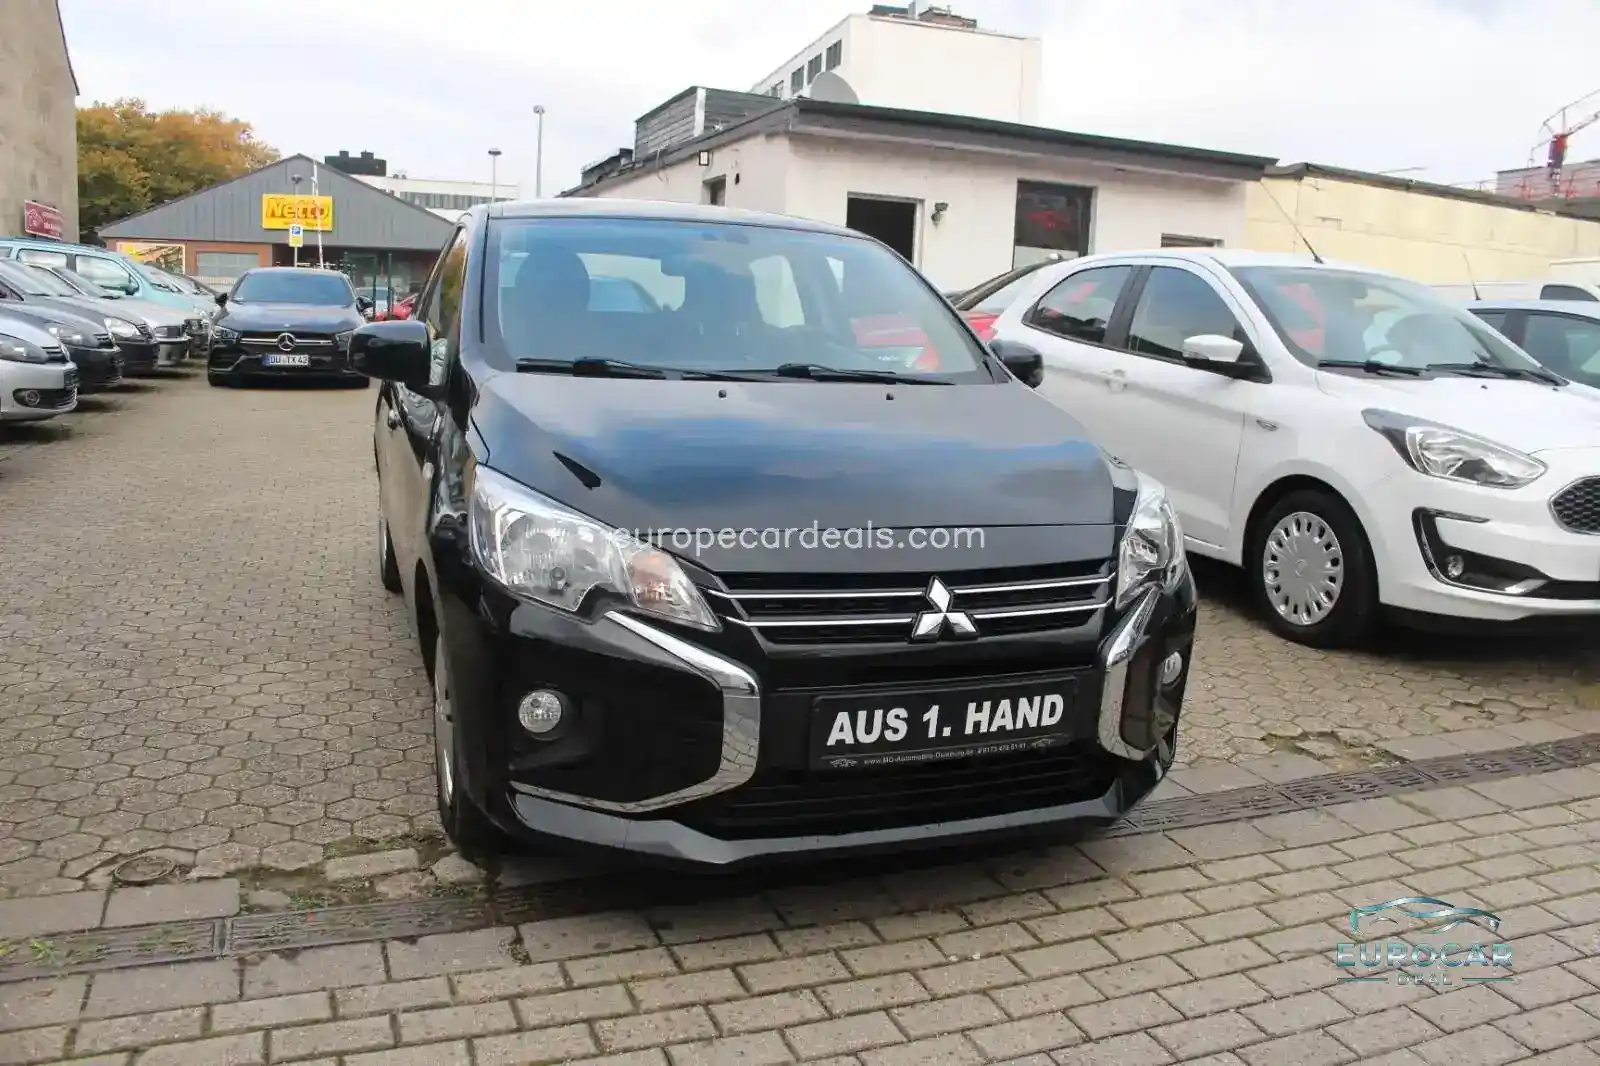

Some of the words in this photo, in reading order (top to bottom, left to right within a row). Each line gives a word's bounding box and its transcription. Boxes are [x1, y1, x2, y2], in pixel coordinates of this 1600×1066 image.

[266, 197, 330, 220] Netto
[826, 708, 909, 746] AUS
[922, 705, 952, 738] 1.
[964, 694, 1064, 735] HAND
